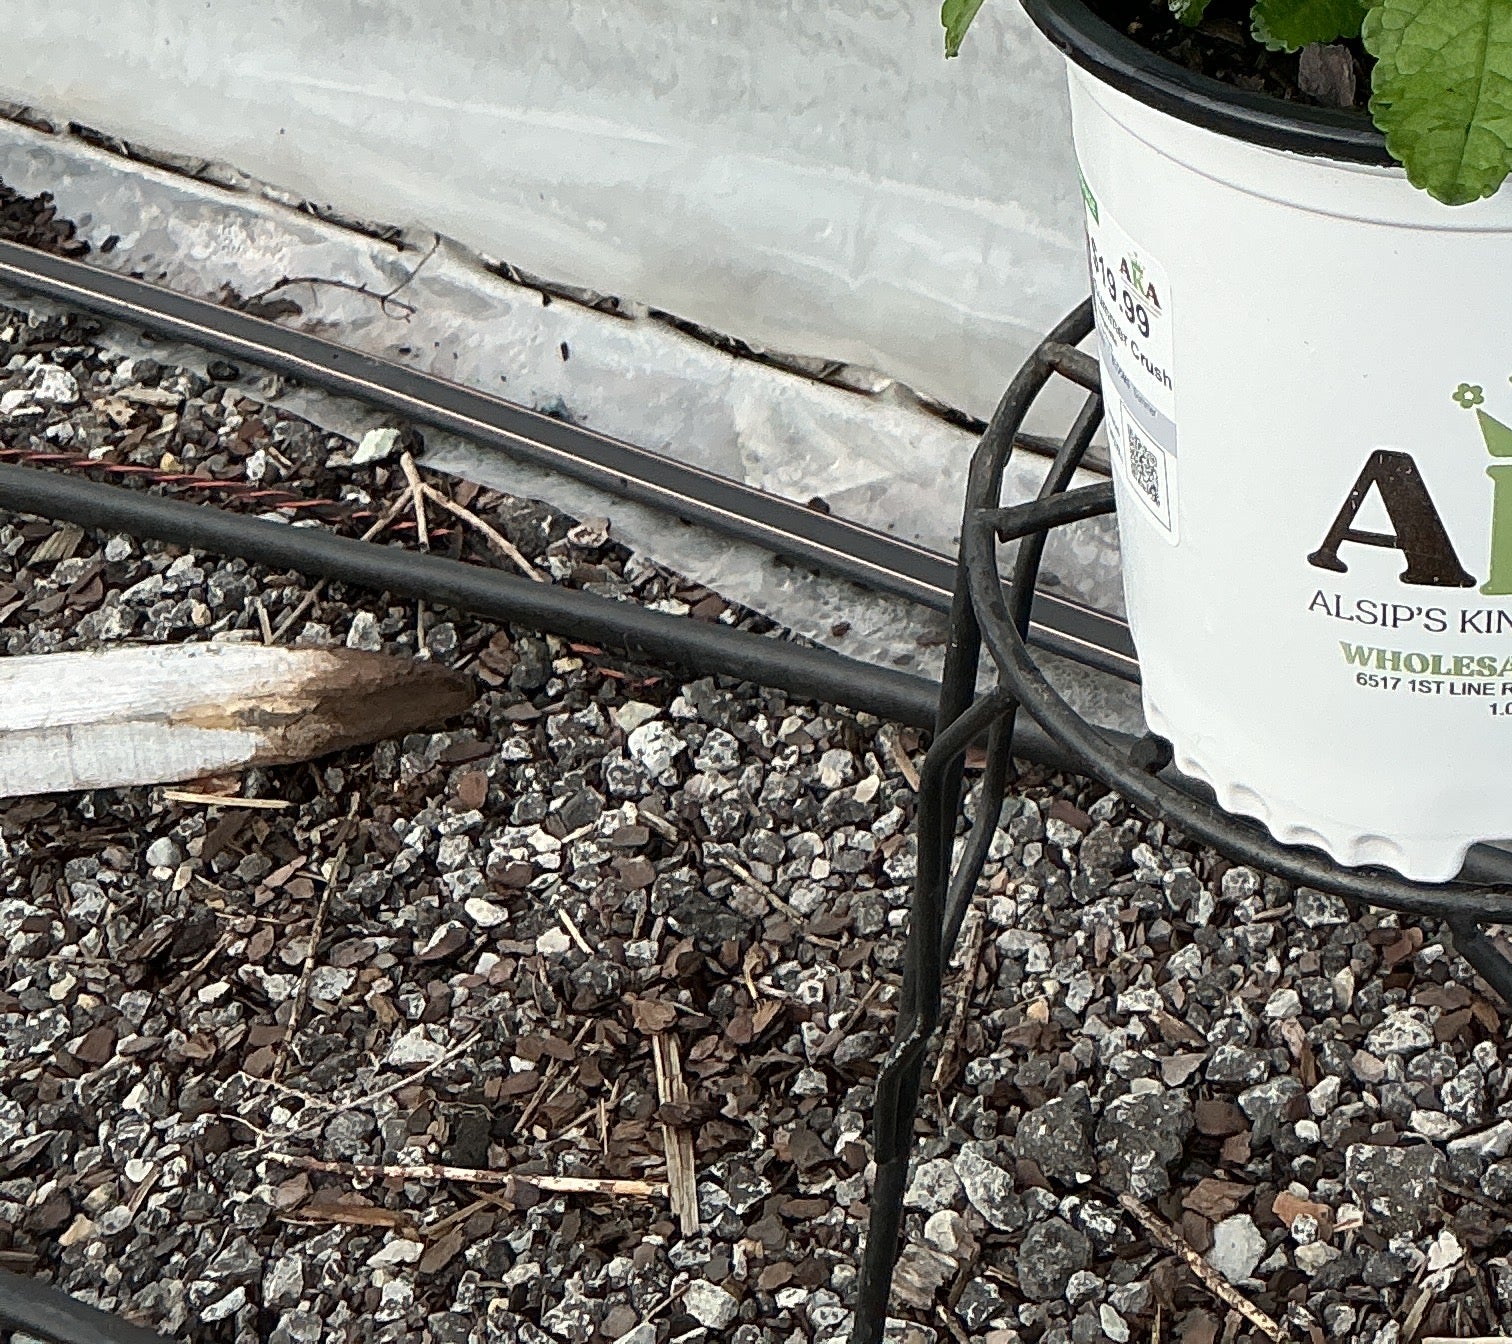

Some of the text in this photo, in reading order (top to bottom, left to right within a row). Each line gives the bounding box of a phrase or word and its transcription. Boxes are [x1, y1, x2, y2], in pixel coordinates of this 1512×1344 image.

[1130, 340, 1173, 392] Crush
[1308, 589, 1448, 633] ALSIP'S
[1355, 671, 1402, 691] 6517
[1408, 679, 1445, 696] 1ST
[1449, 679, 1496, 697] LINE
